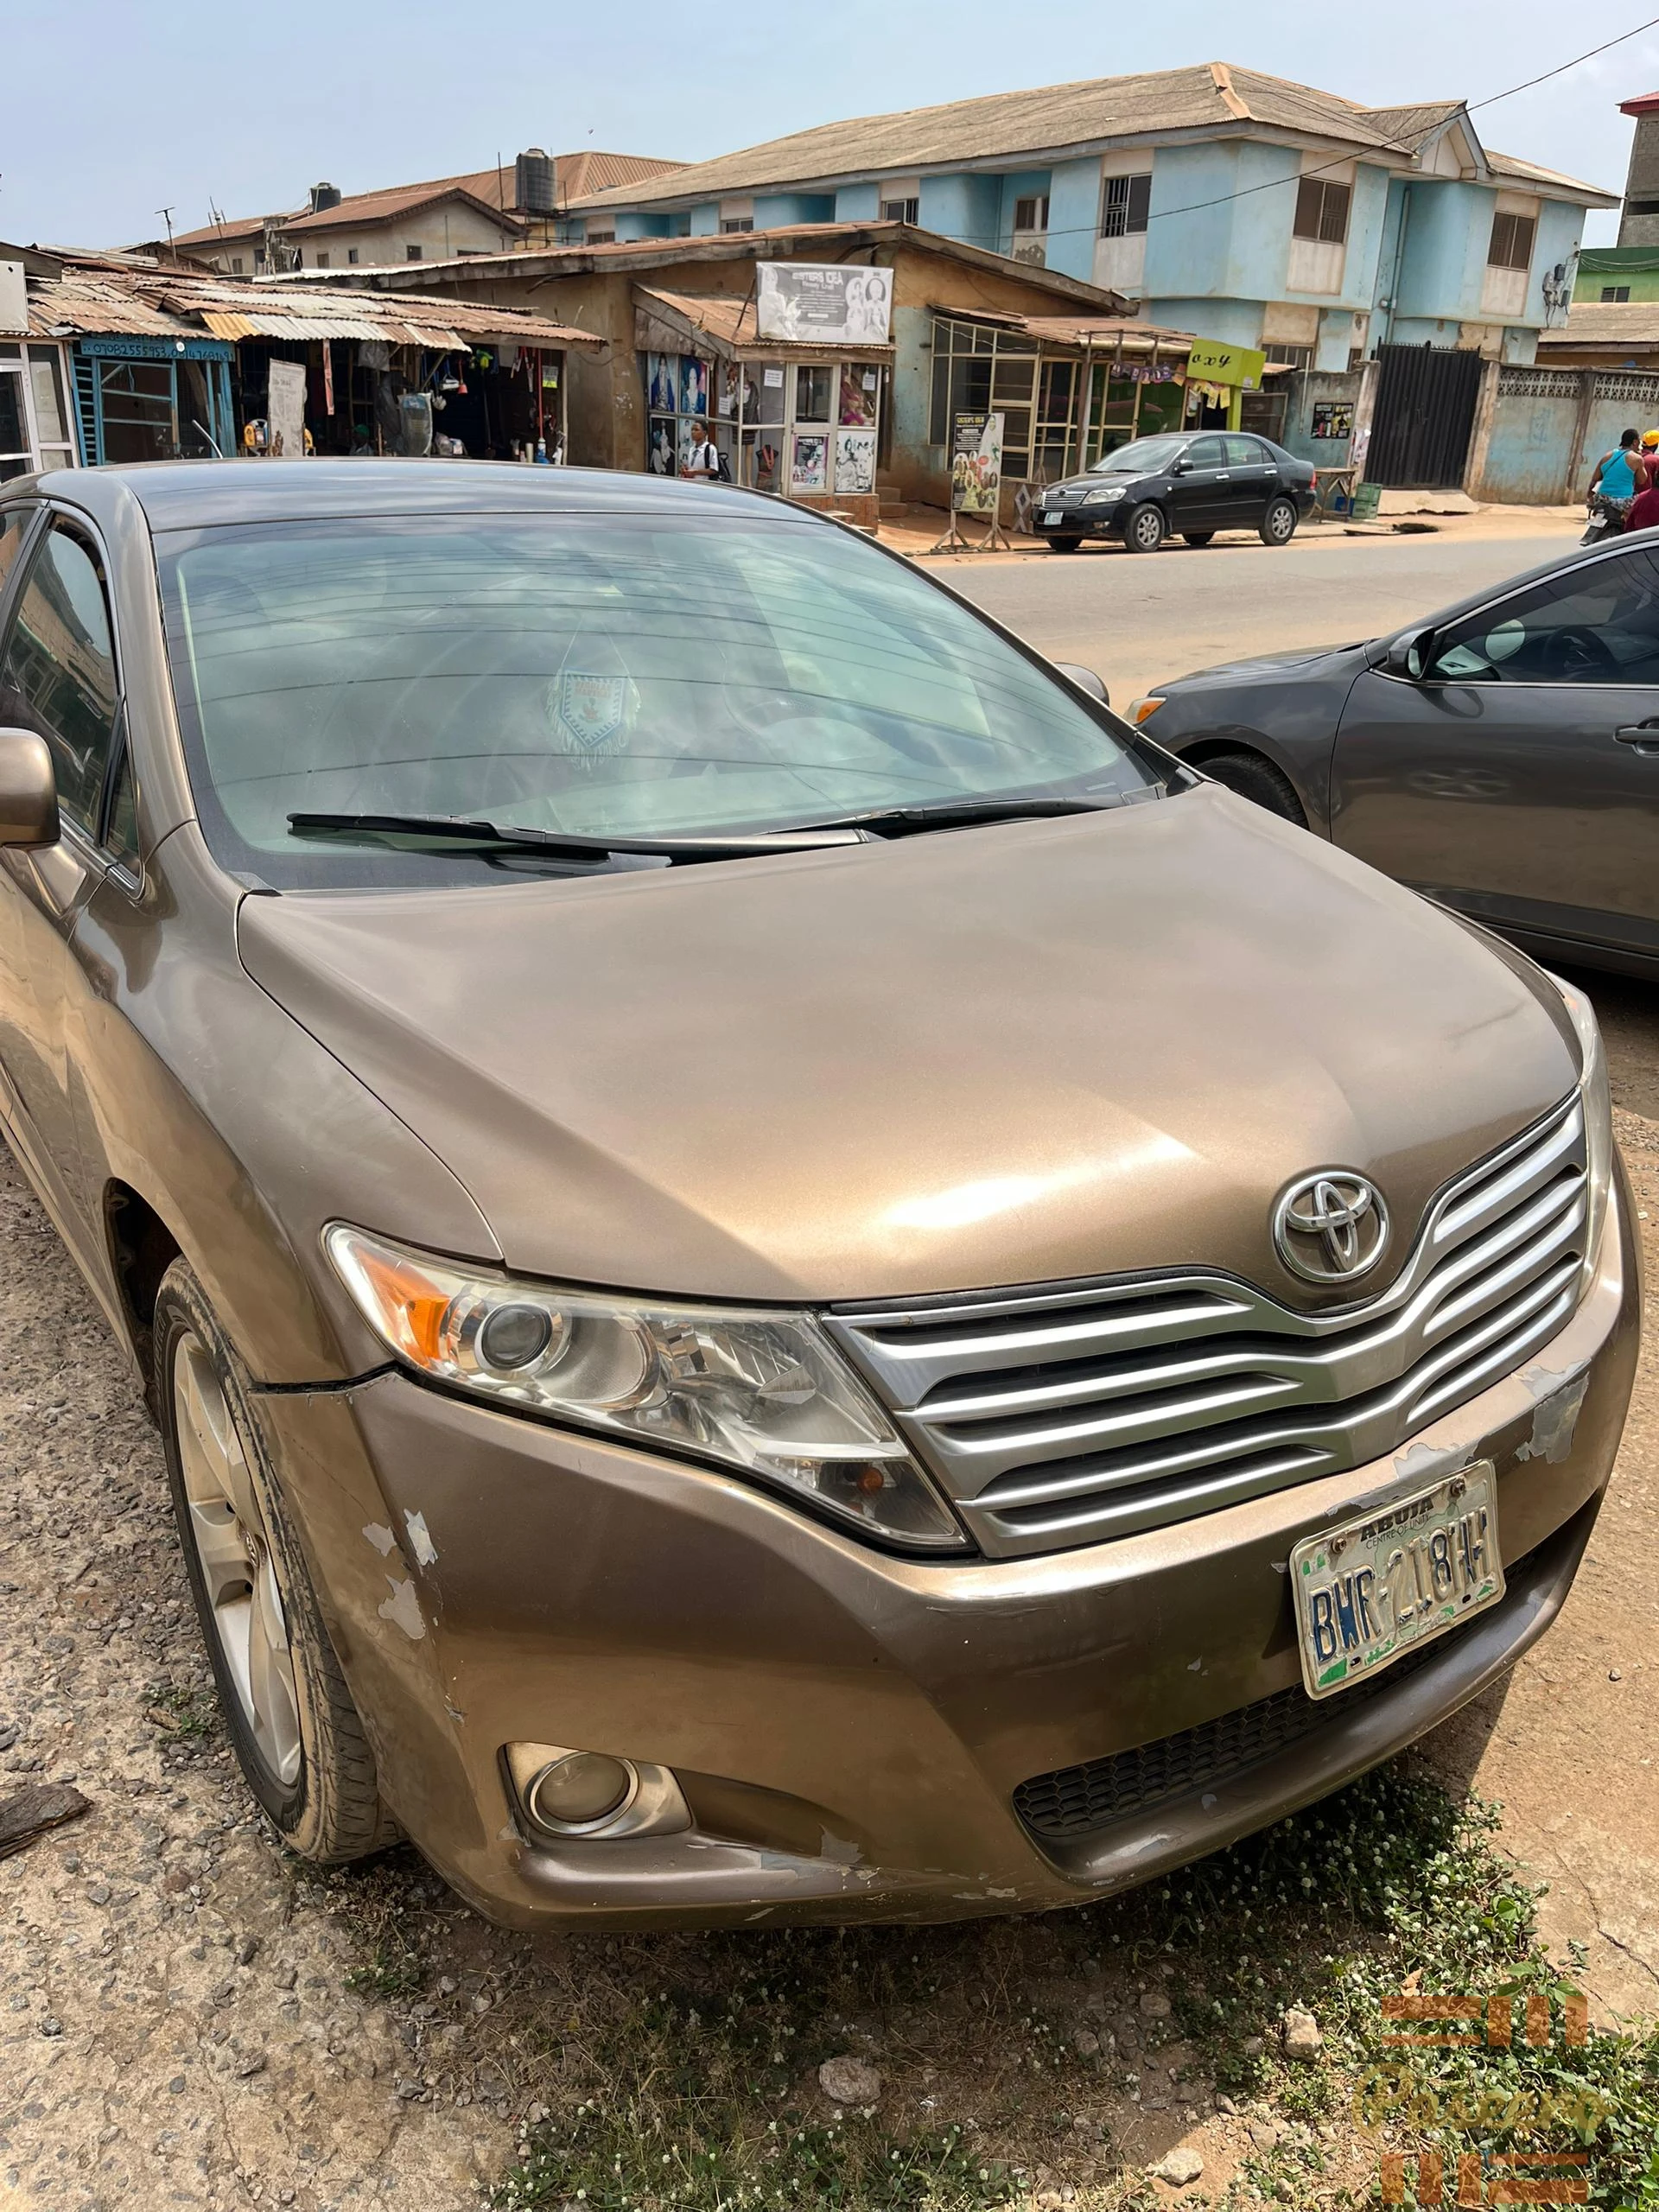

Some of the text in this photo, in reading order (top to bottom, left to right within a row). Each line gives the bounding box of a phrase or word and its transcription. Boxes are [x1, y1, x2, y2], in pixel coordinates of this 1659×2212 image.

[1361, 1497, 1434, 1542] ABUJA
[1365, 1513, 1430, 1549] CENTRE OF UNITY
